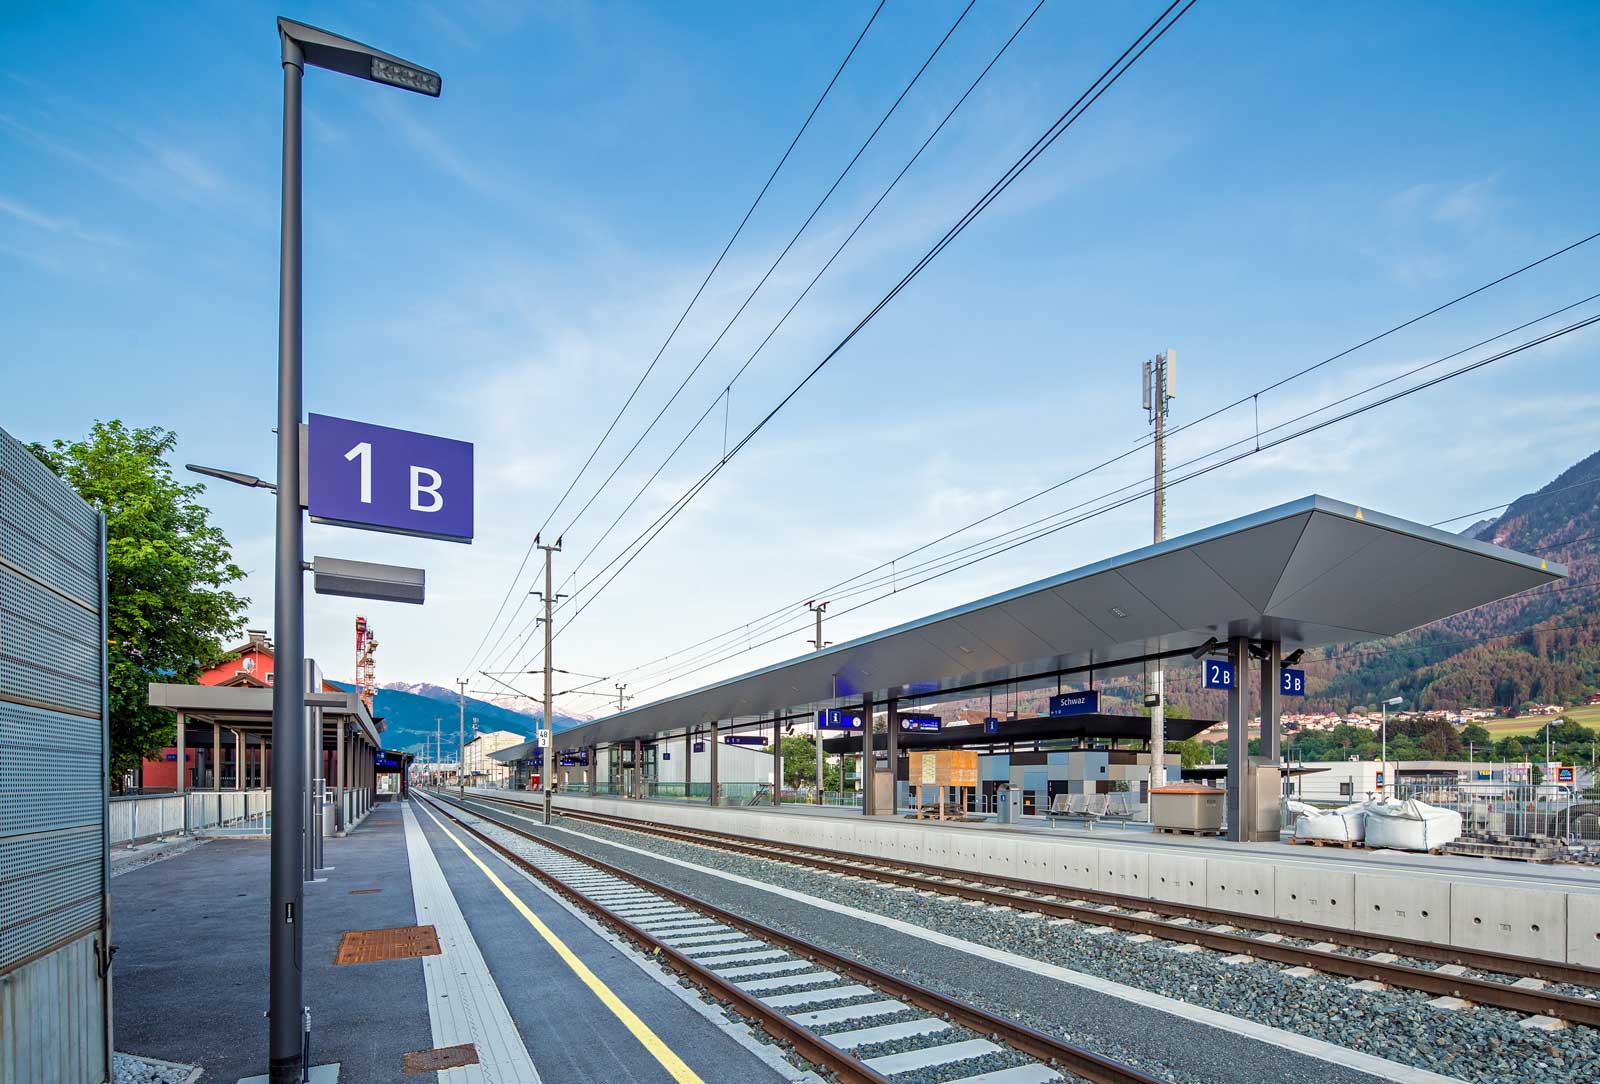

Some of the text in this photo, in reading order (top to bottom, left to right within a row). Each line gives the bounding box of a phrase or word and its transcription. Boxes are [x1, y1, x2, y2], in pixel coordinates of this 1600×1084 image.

[344, 442, 443, 512] 1 B
[1211, 665, 1230, 684] 2 B
[1284, 673, 1301, 691] 3 B
[1060, 697, 1085, 706] Schwaz
